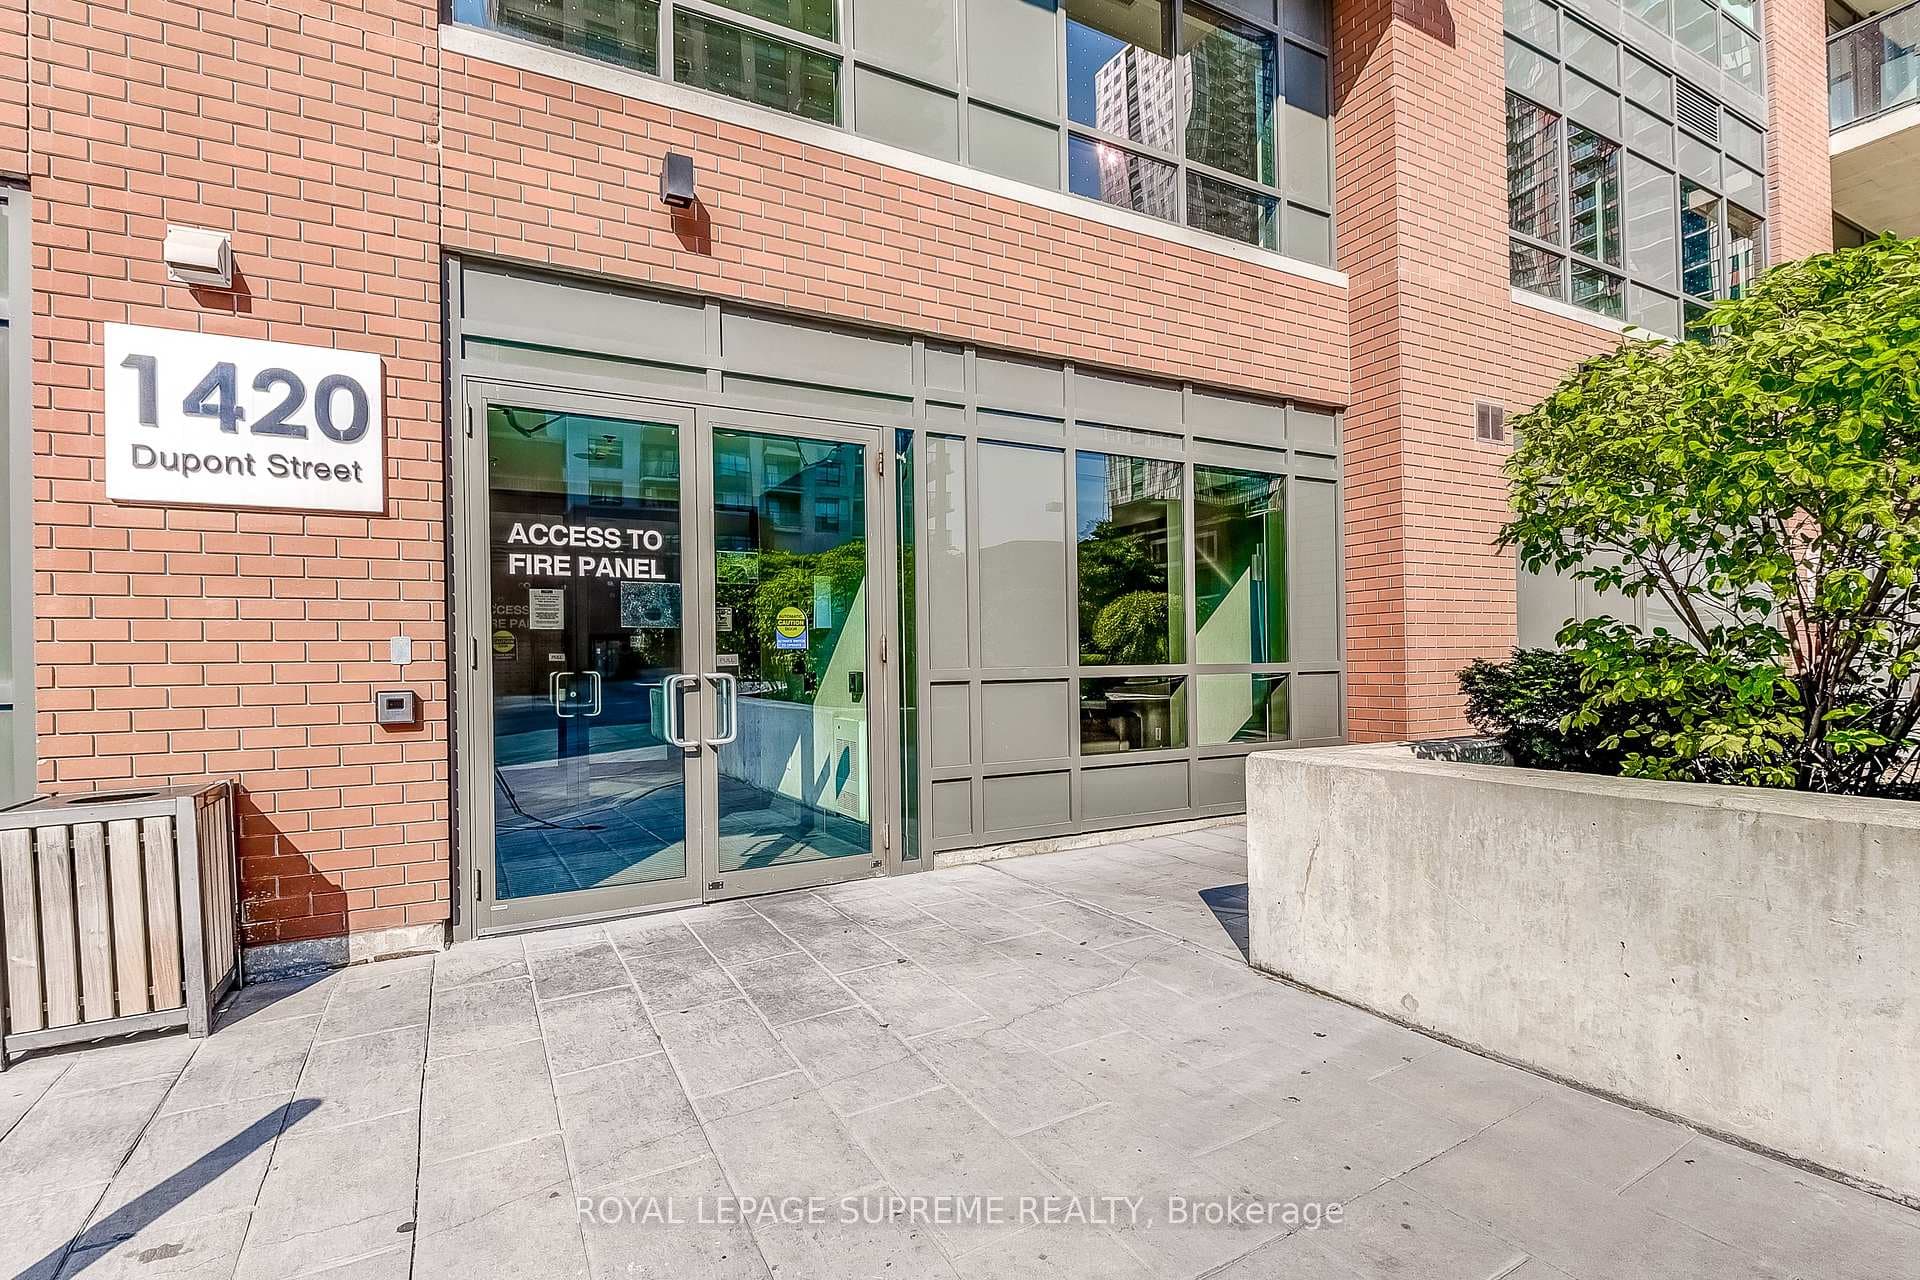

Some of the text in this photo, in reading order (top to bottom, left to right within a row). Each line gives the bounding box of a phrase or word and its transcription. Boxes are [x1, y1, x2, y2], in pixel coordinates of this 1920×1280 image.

[119, 353, 370, 444] 1420
[131, 444, 363, 484] Dupont Street
[507, 522, 663, 550] ACCESS TO
[508, 553, 666, 580] FIRE PANEL
